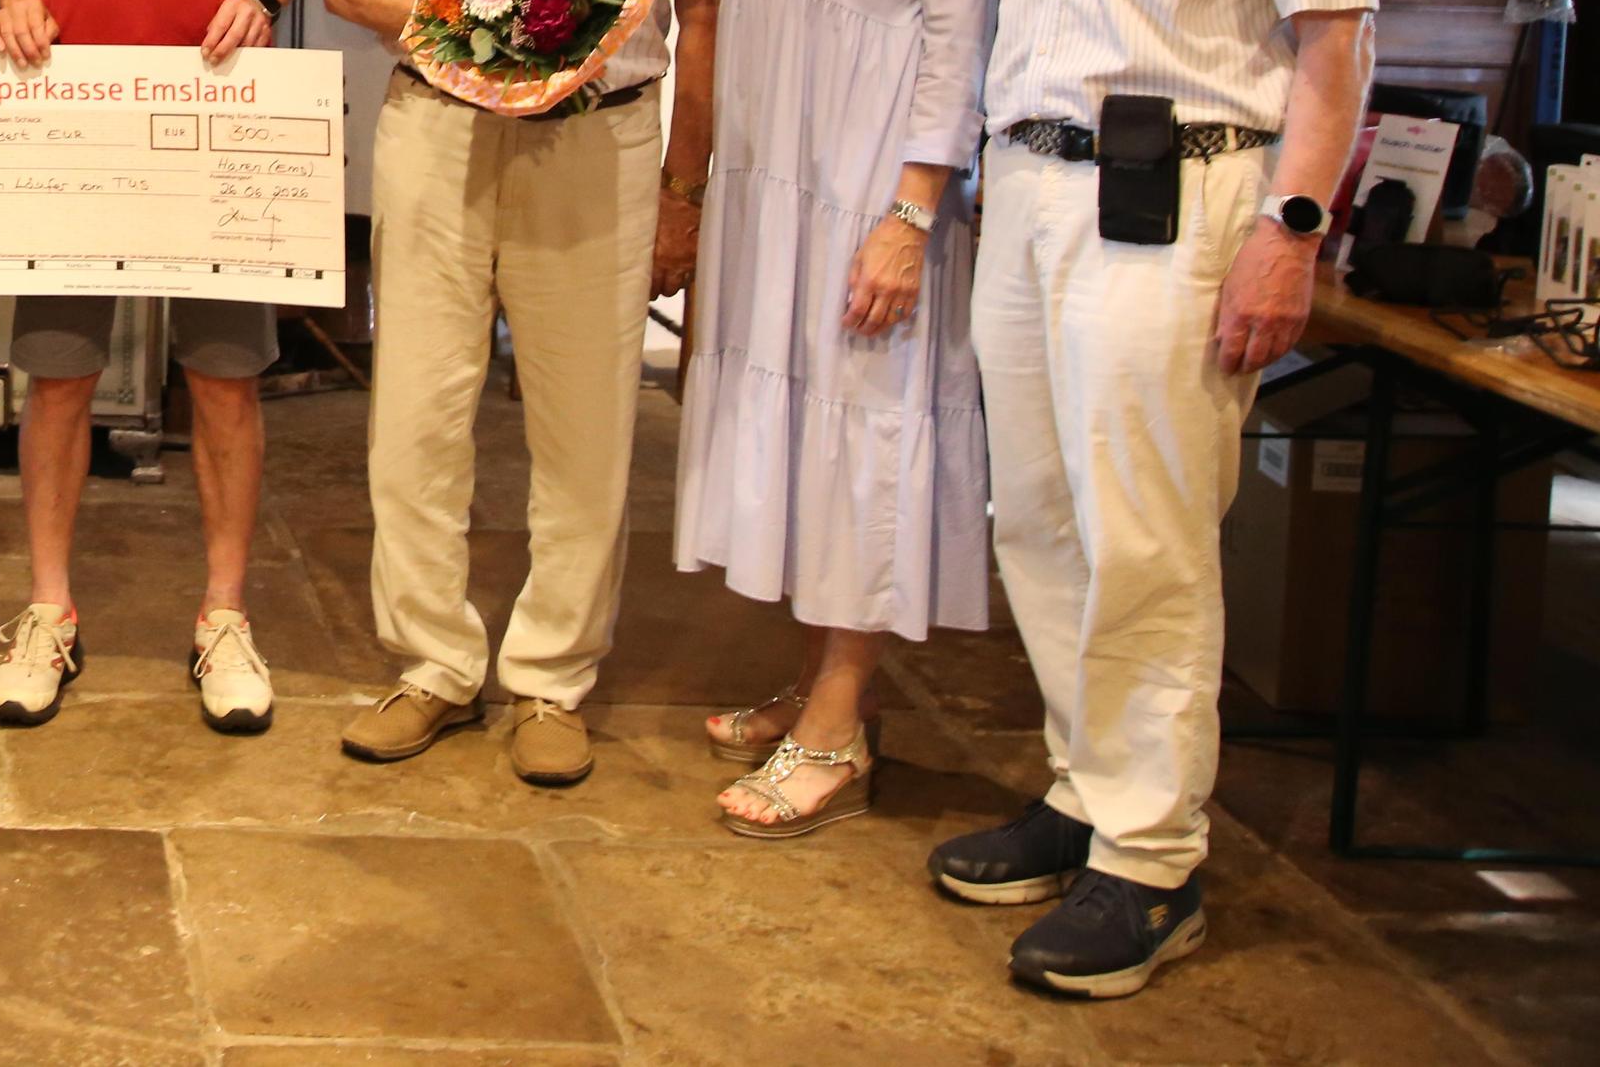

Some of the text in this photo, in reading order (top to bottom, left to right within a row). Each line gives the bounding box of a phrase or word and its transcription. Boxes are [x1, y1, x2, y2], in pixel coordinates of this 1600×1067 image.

[134, 77, 256, 103] Emsland
[46, 129, 86, 141] EUR
[164, 128, 186, 137] EUR
[217, 157, 314, 178] Haren (Ems)
[272, 185, 310, 199] 2026
